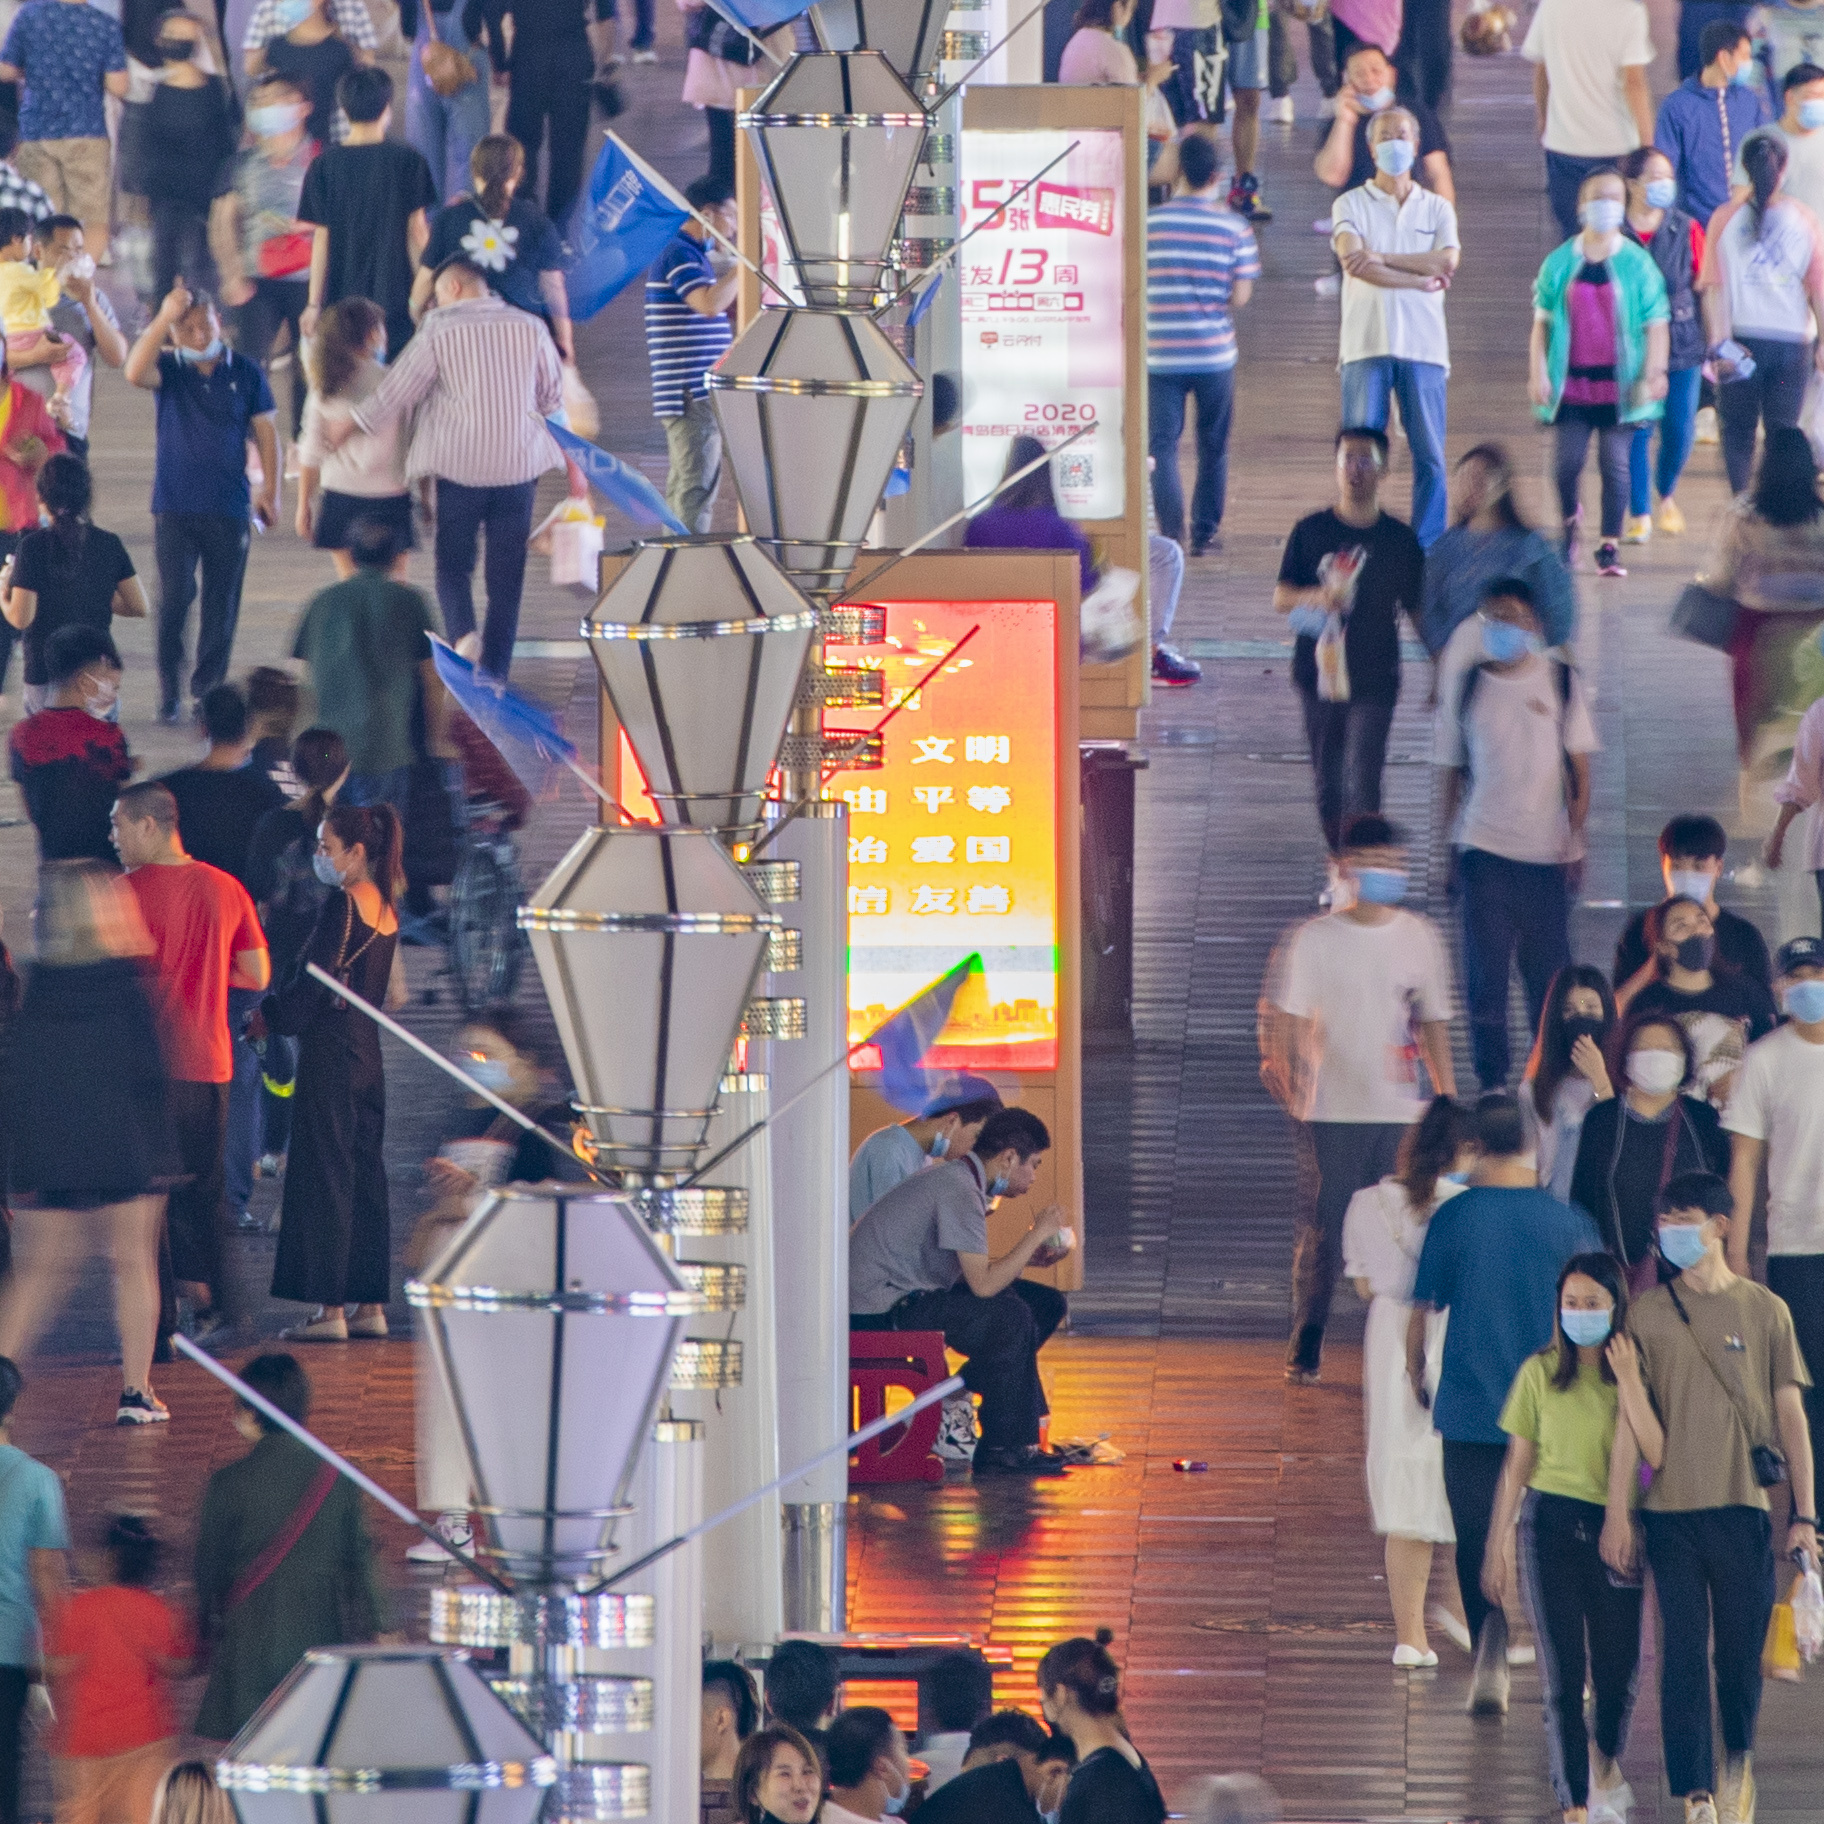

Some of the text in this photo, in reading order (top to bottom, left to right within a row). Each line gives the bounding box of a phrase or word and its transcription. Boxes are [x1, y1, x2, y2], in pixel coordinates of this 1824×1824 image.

[1024, 403, 1097, 422] 2020
[910, 734, 1011, 764] 文明
[910, 785, 1012, 815] 平等
[910, 834, 1011, 864] 爱国
[910, 884, 1012, 914] 友善
